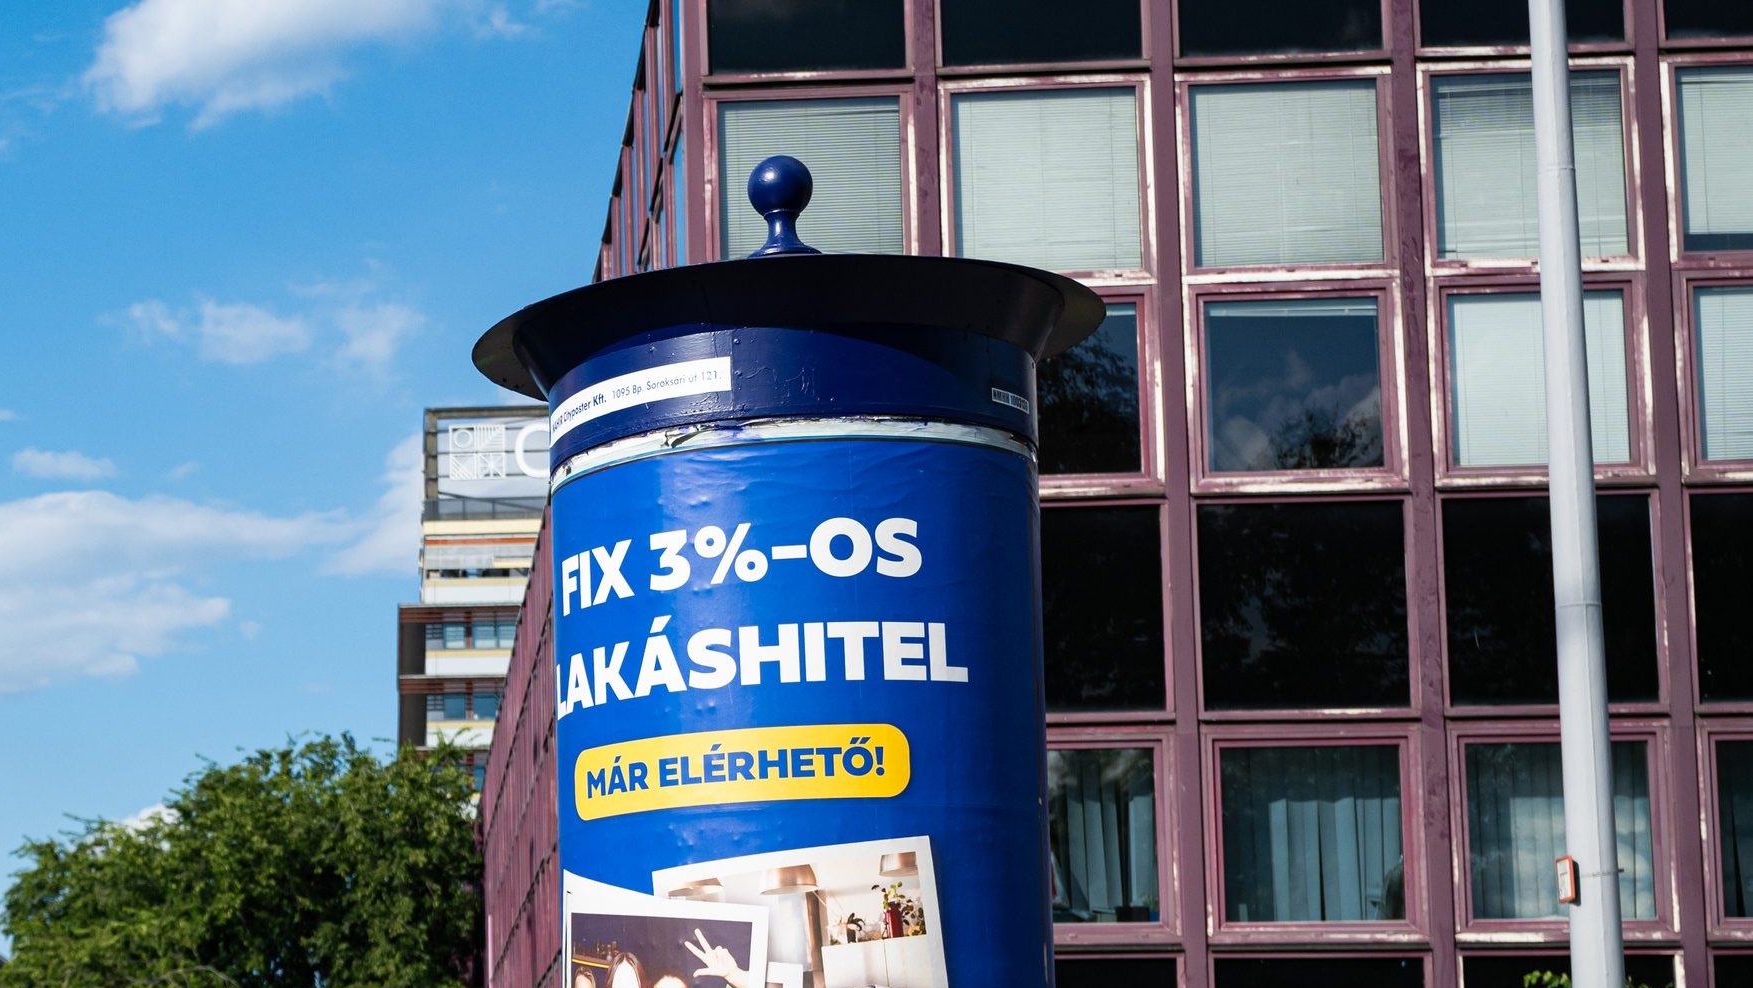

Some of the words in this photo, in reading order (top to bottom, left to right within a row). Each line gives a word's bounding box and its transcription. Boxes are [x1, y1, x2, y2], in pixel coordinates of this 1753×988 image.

[564, 401, 591, 422] Cityposter
[593, 393, 607, 406] Kft.
[612, 386, 630, 399] 1095
[632, 384, 644, 397] Bp.
[562, 539, 635, 617] FIX
[649, 517, 923, 591] 3%-OS
[556, 615, 969, 721] LAKÁSHITEL
[586, 755, 649, 799] MÁR
[658, 736, 886, 787] ELÉRHETŐ!
